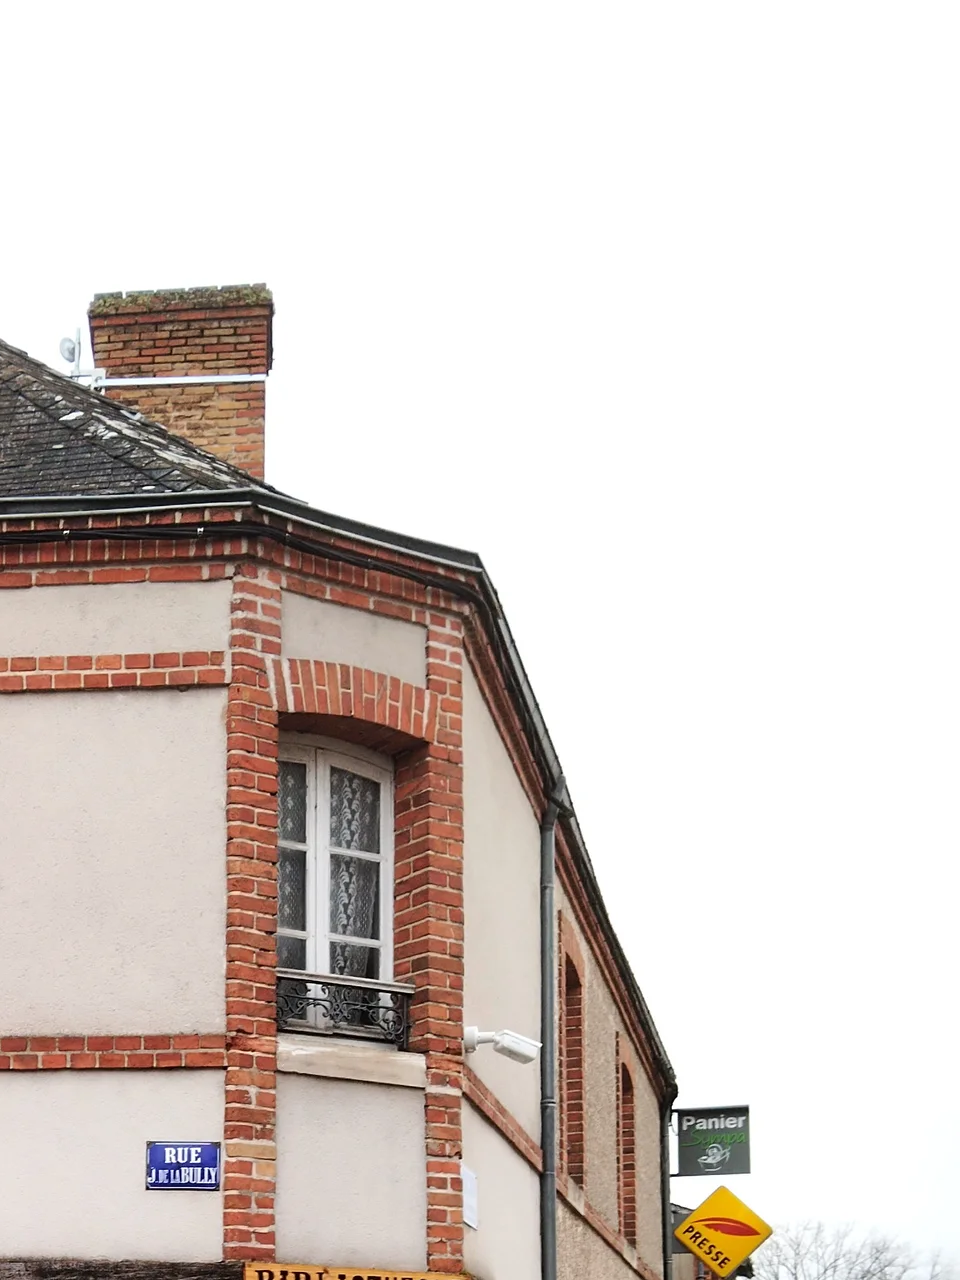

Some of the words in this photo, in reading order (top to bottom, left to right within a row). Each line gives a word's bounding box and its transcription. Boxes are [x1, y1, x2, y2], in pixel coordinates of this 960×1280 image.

[681, 1114, 747, 1131] Panier
[680, 1128, 746, 1147] Sympa
[164, 1147, 202, 1164] RUE
[181, 1166, 218, 1184] BULLY
[682, 1225, 731, 1269] PRESSE
